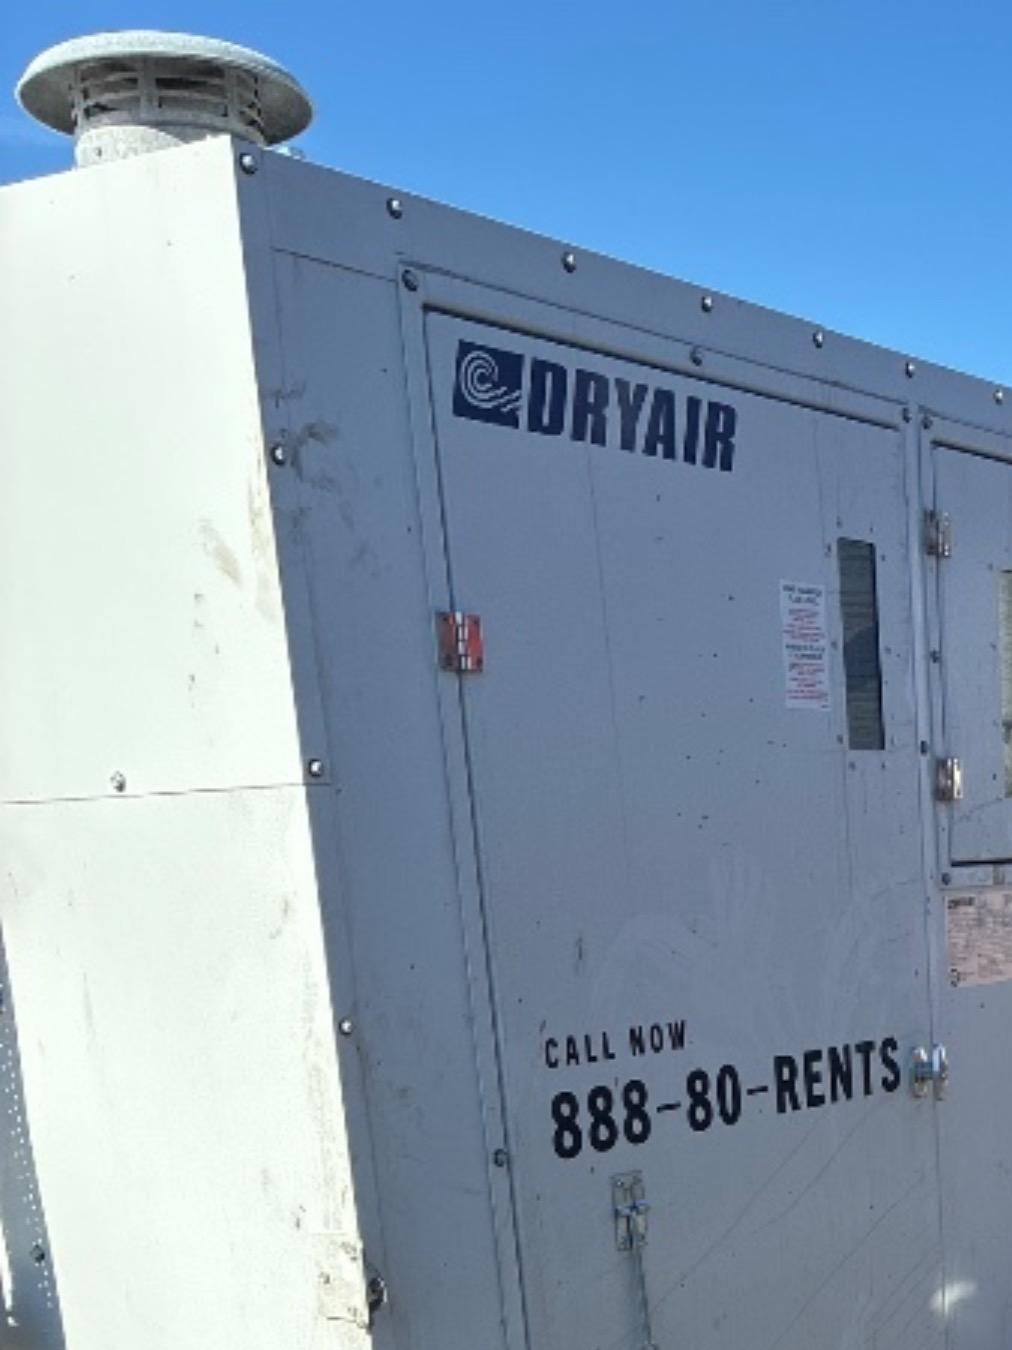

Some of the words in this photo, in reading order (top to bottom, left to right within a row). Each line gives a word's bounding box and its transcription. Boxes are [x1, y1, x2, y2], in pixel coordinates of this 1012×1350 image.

[527, 356, 737, 472] DRYAIR
[545, 1031, 615, 1068] CALL
[629, 1020, 686, 1057] NOW
[551, 1037, 901, 1160] 888-80-RENTS
